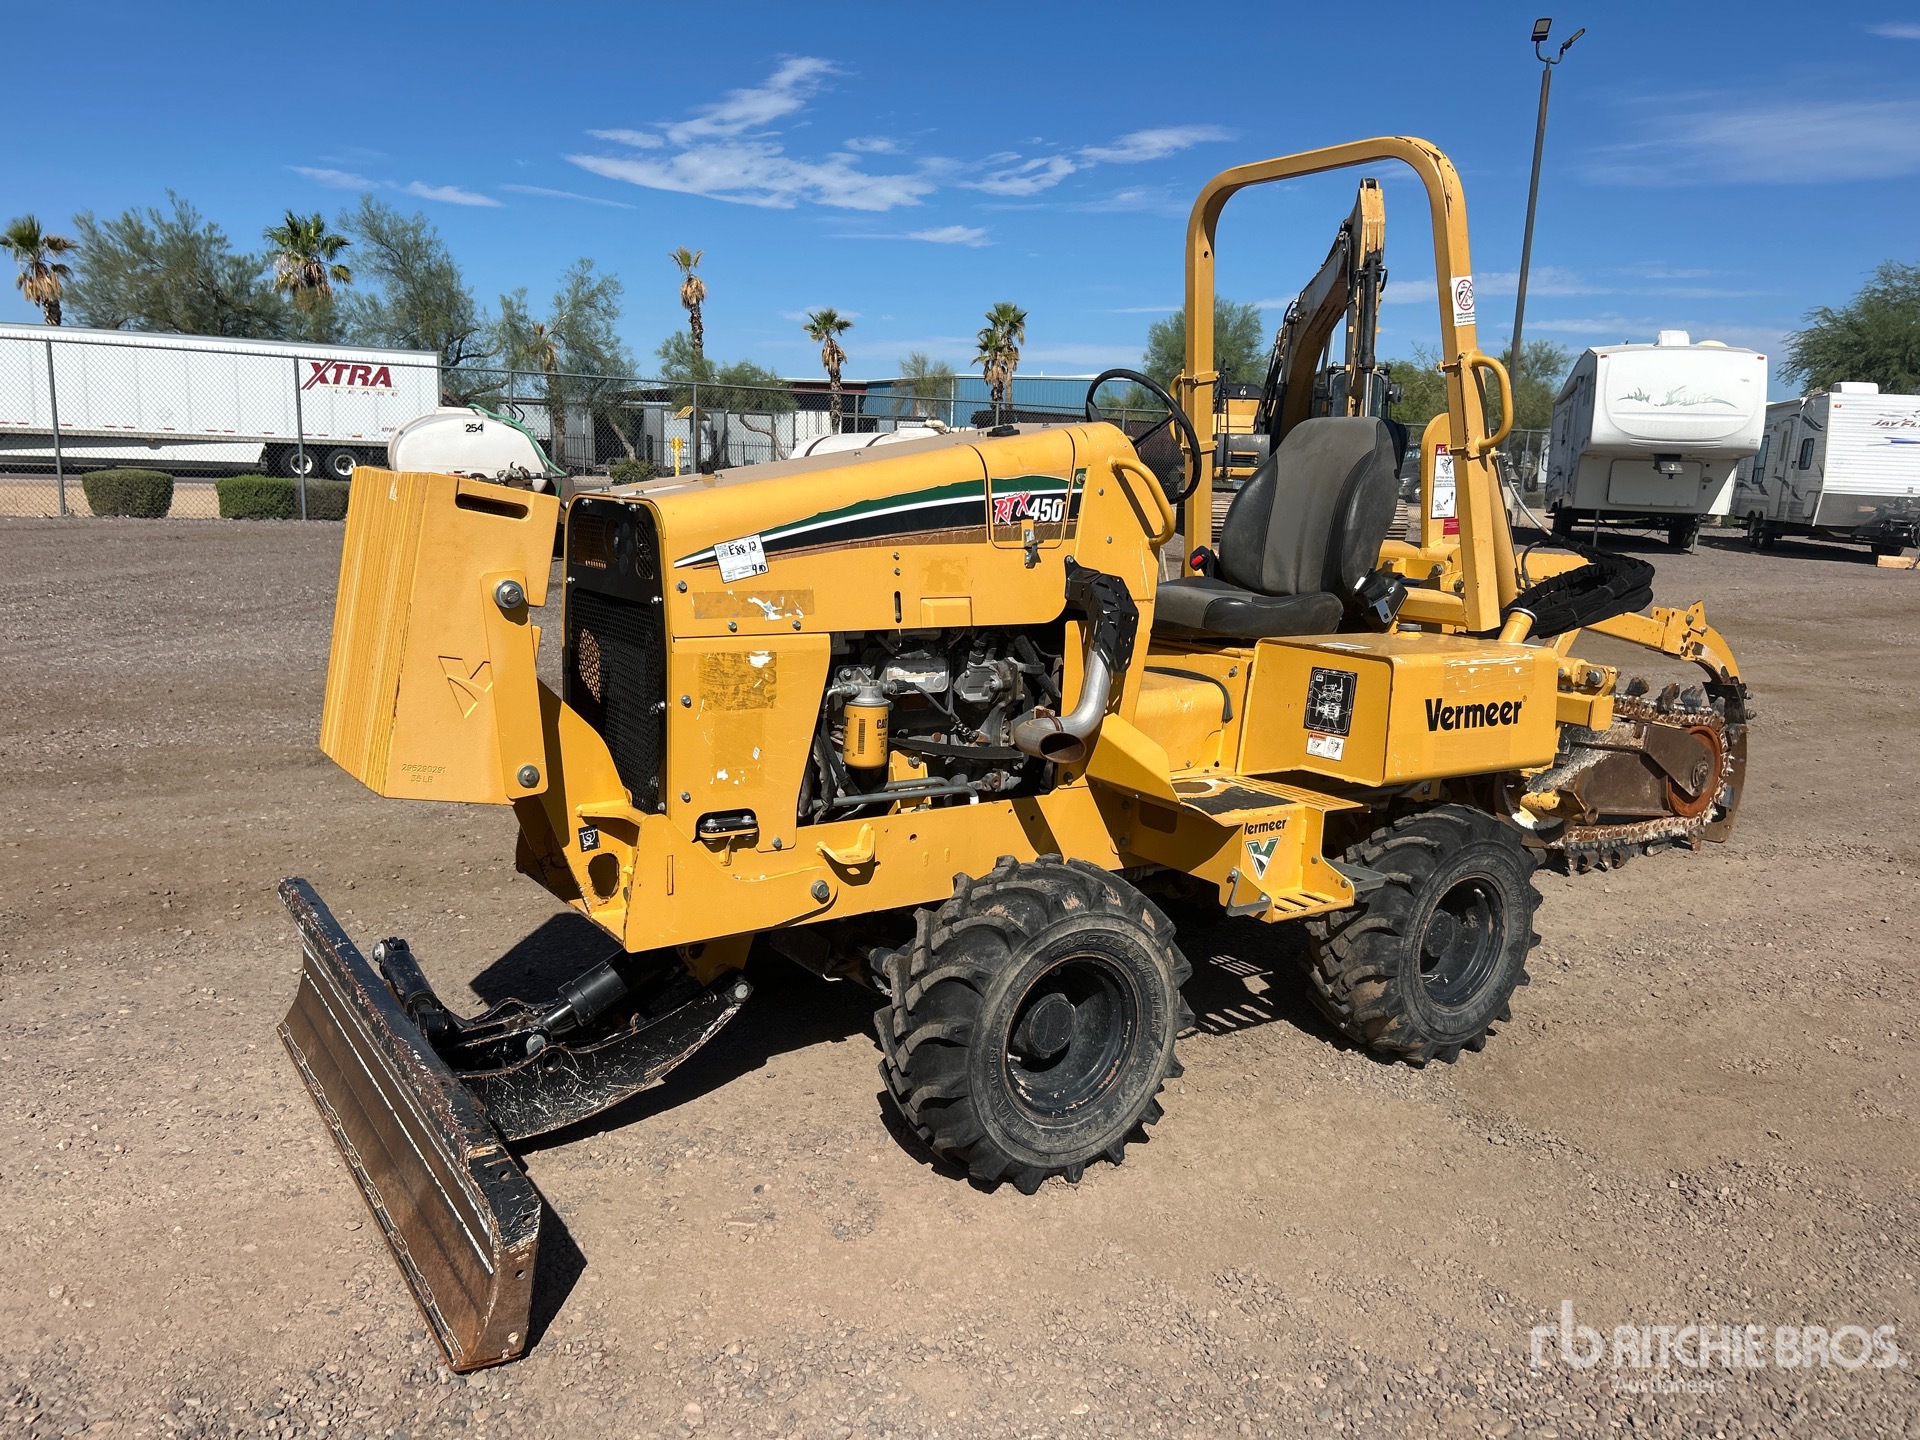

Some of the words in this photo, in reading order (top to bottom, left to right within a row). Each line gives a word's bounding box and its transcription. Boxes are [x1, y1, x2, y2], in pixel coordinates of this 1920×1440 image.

[301, 360, 393, 390] XTRA
[465, 423, 484, 433] 254
[1425, 698, 1523, 732] Vermeer
